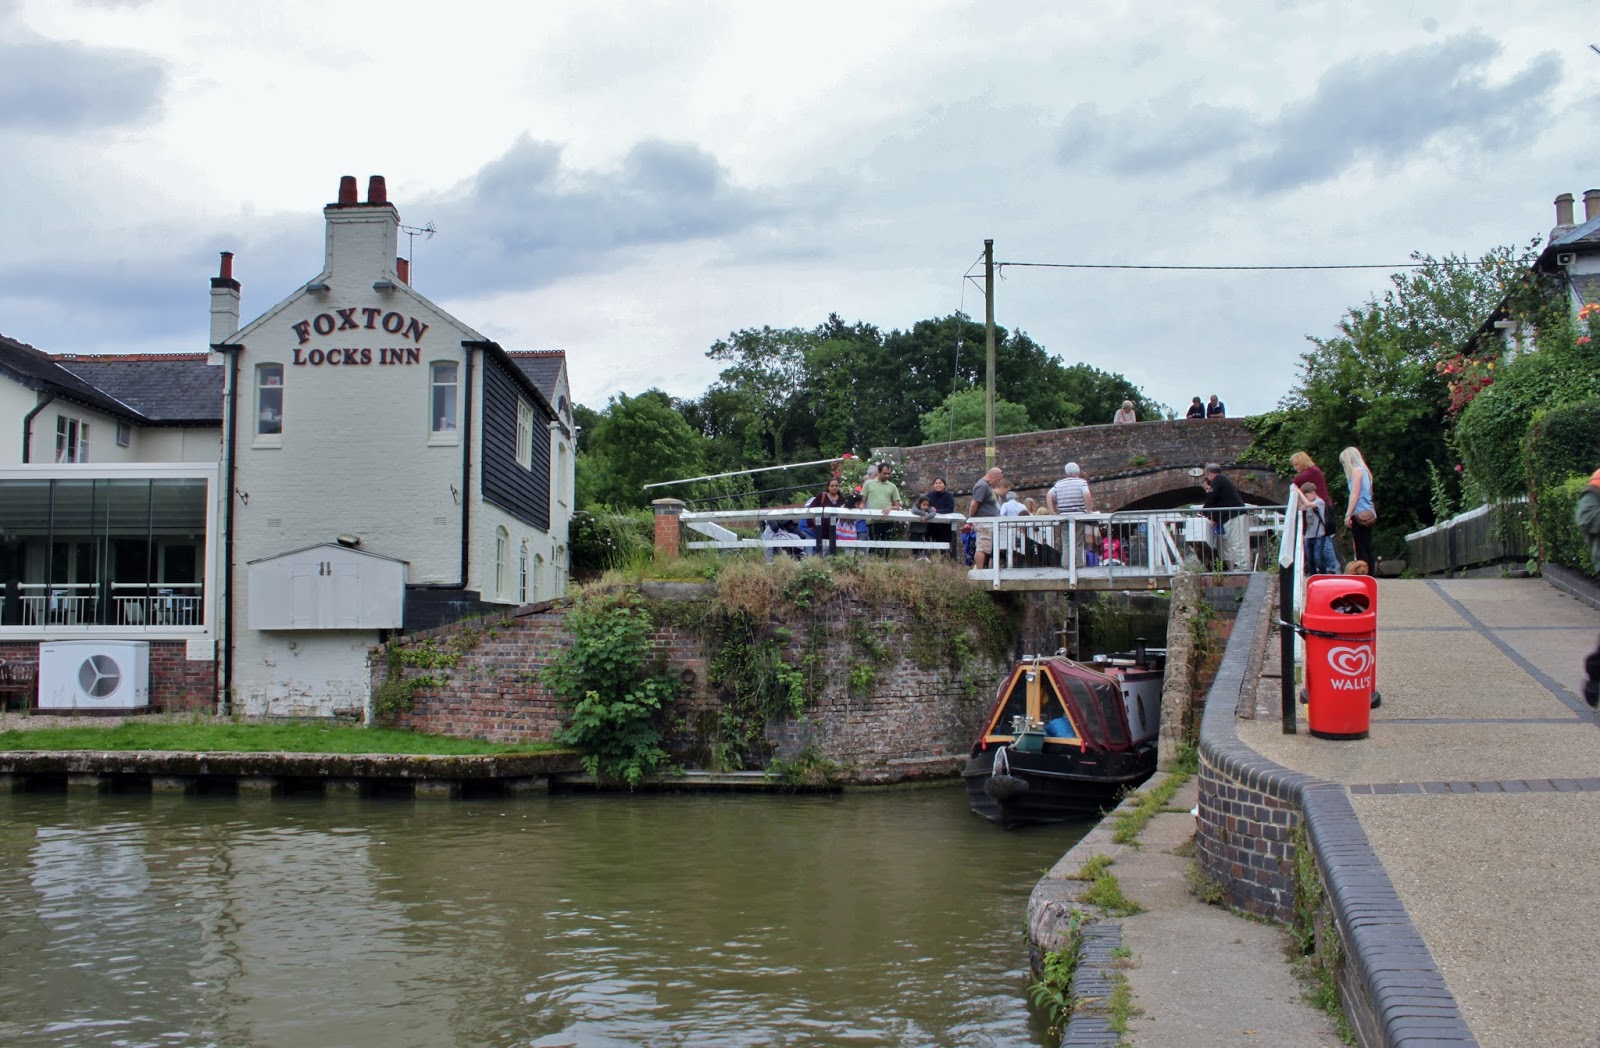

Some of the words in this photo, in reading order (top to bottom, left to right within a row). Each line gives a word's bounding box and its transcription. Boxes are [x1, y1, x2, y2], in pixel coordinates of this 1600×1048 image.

[291, 307, 429, 344] FOXTON
[292, 348, 373, 366] LOCKS
[379, 347, 421, 365] INN
[1330, 676, 1370, 690] WALL'S
